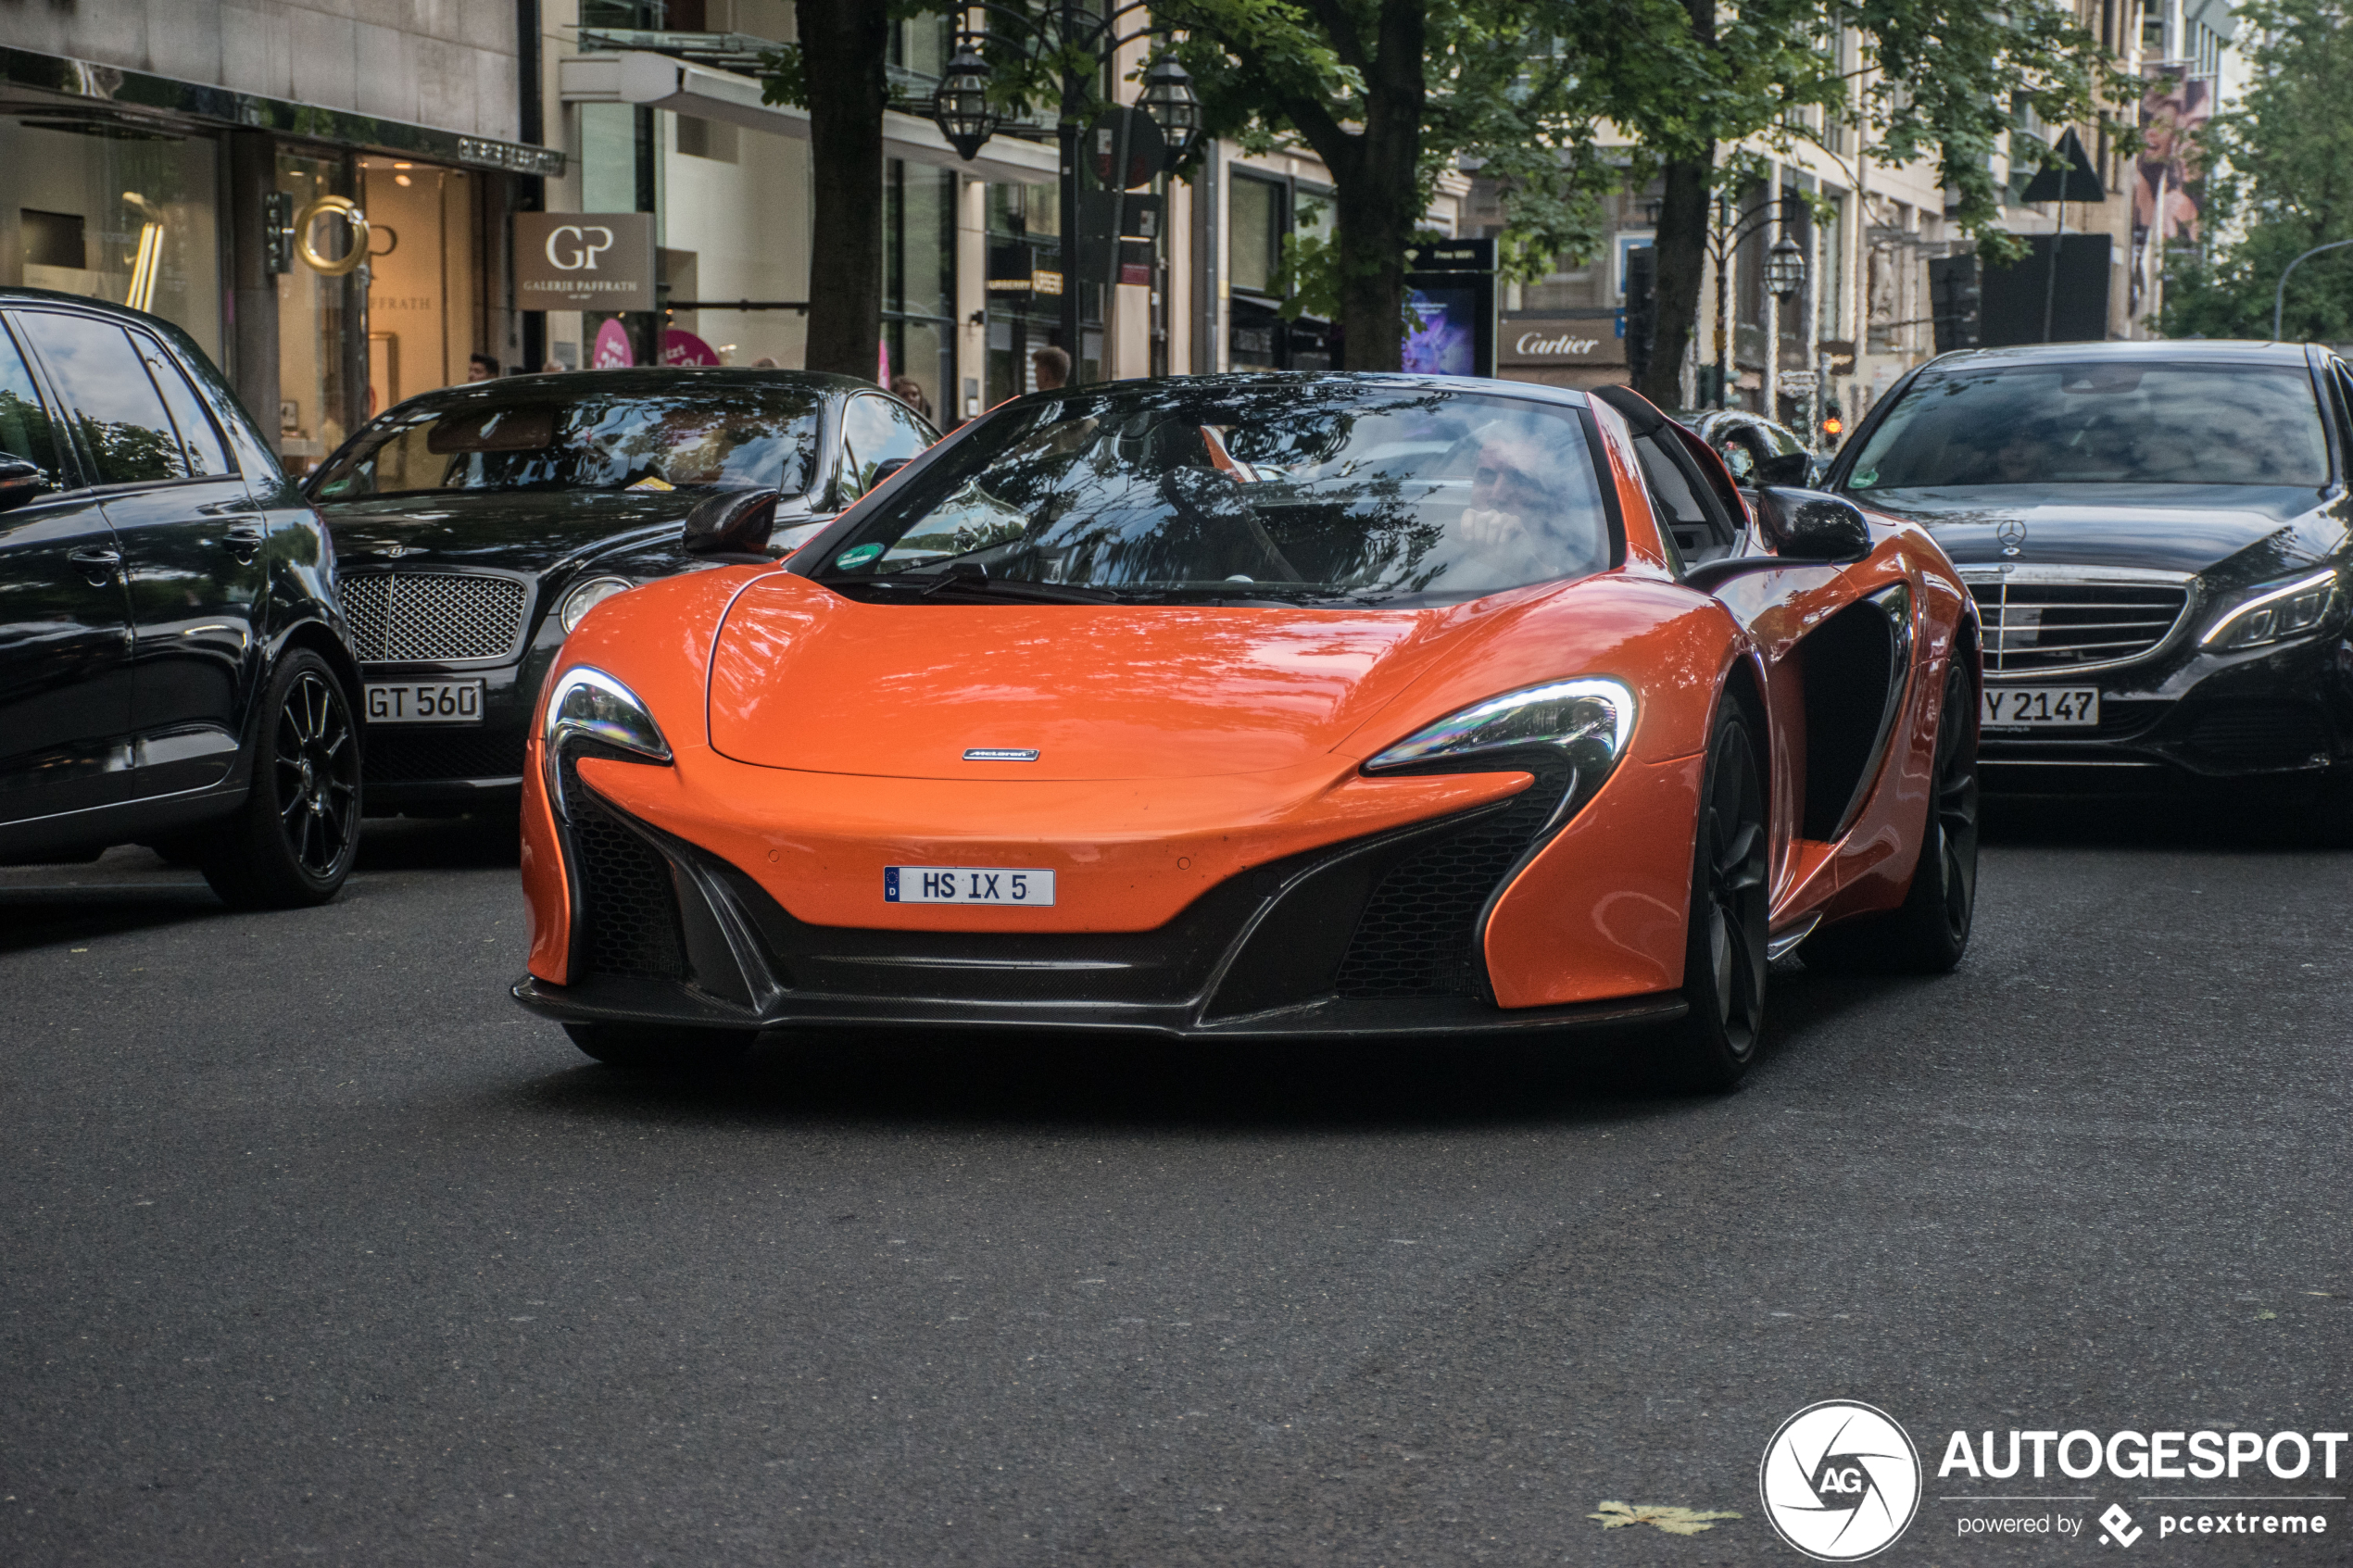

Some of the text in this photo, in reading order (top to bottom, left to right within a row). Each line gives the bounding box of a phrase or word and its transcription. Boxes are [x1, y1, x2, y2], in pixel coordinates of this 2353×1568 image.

[546, 225, 613, 270] GP
[522, 281, 637, 292] GALERIE PAFFRATH
[370, 297, 431, 310] FFRATH
[1516, 332, 1599, 355] Cartier
[370, 686, 477, 718] GT 560
[1984, 691, 2094, 721] Y 2147
[889, 887, 897, 896] D
[924, 872, 1027, 900] HS IX 5
